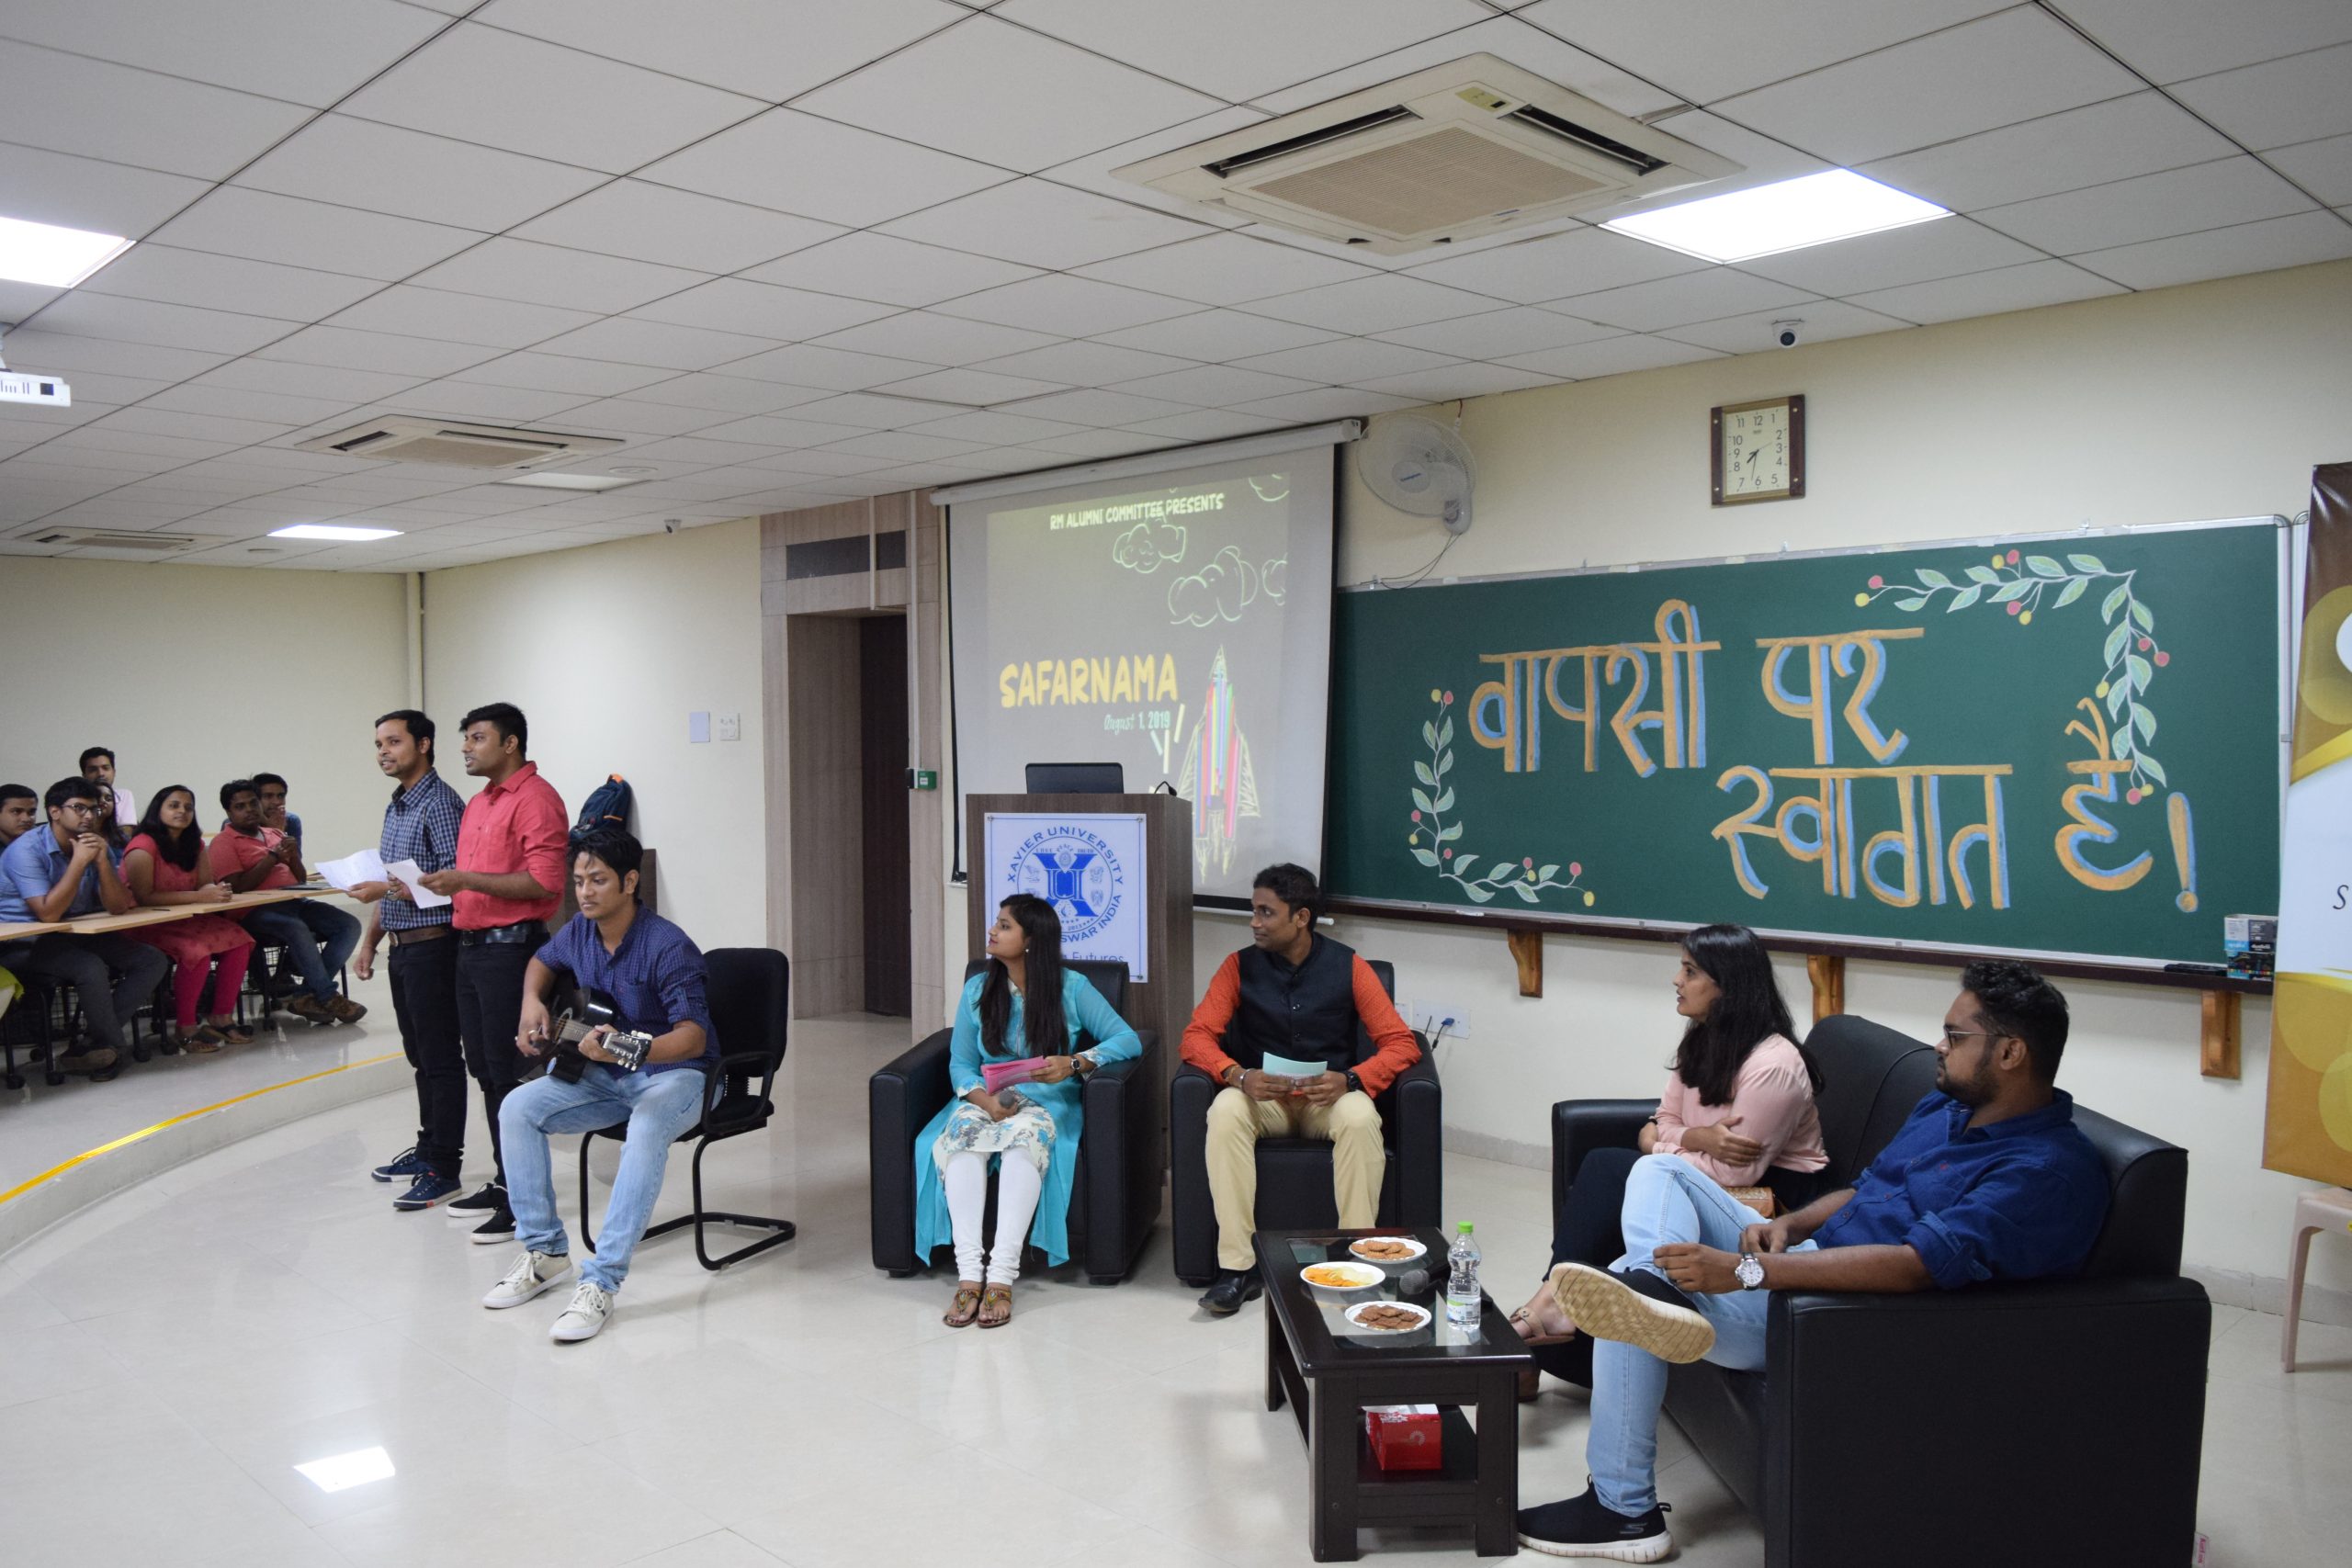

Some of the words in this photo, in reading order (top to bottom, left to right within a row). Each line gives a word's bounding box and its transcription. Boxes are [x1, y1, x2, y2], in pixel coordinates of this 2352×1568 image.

[1737, 418, 1745, 428] 11
[1753, 415, 1763, 426] 12
[1733, 434, 1743, 446] 10
[1776, 429, 1782, 440] 2
[1734, 448, 1740, 458] 9
[1776, 443, 1782, 454] 3
[1734, 461, 1740, 472] 8
[1776, 457, 1782, 466] 4
[1739, 477, 1745, 488] 7
[1755, 475, 1761, 486] 6
[1771, 473, 1778, 484] 5
[1050, 514, 1064, 530] RM
[1066, 509, 1103, 528] ALUMNI
[1105, 501, 1165, 524] COMMITTEE
[1165, 492, 1226, 515] PRESENTS
[999, 653, 1179, 708] SAFARNAMA
[1469, 599, 1722, 779] वापसी
[1756, 627, 1925, 765] पर
[1104, 713, 1136, 736] August
[1148, 710, 1171, 729] 2019
[1711, 764, 2013, 909] स्वागत
[1008, 831, 1044, 882] XAVIER
[1046, 826, 1124, 885] UNIVERSITY
[1098, 895, 1122, 930] INDIA
